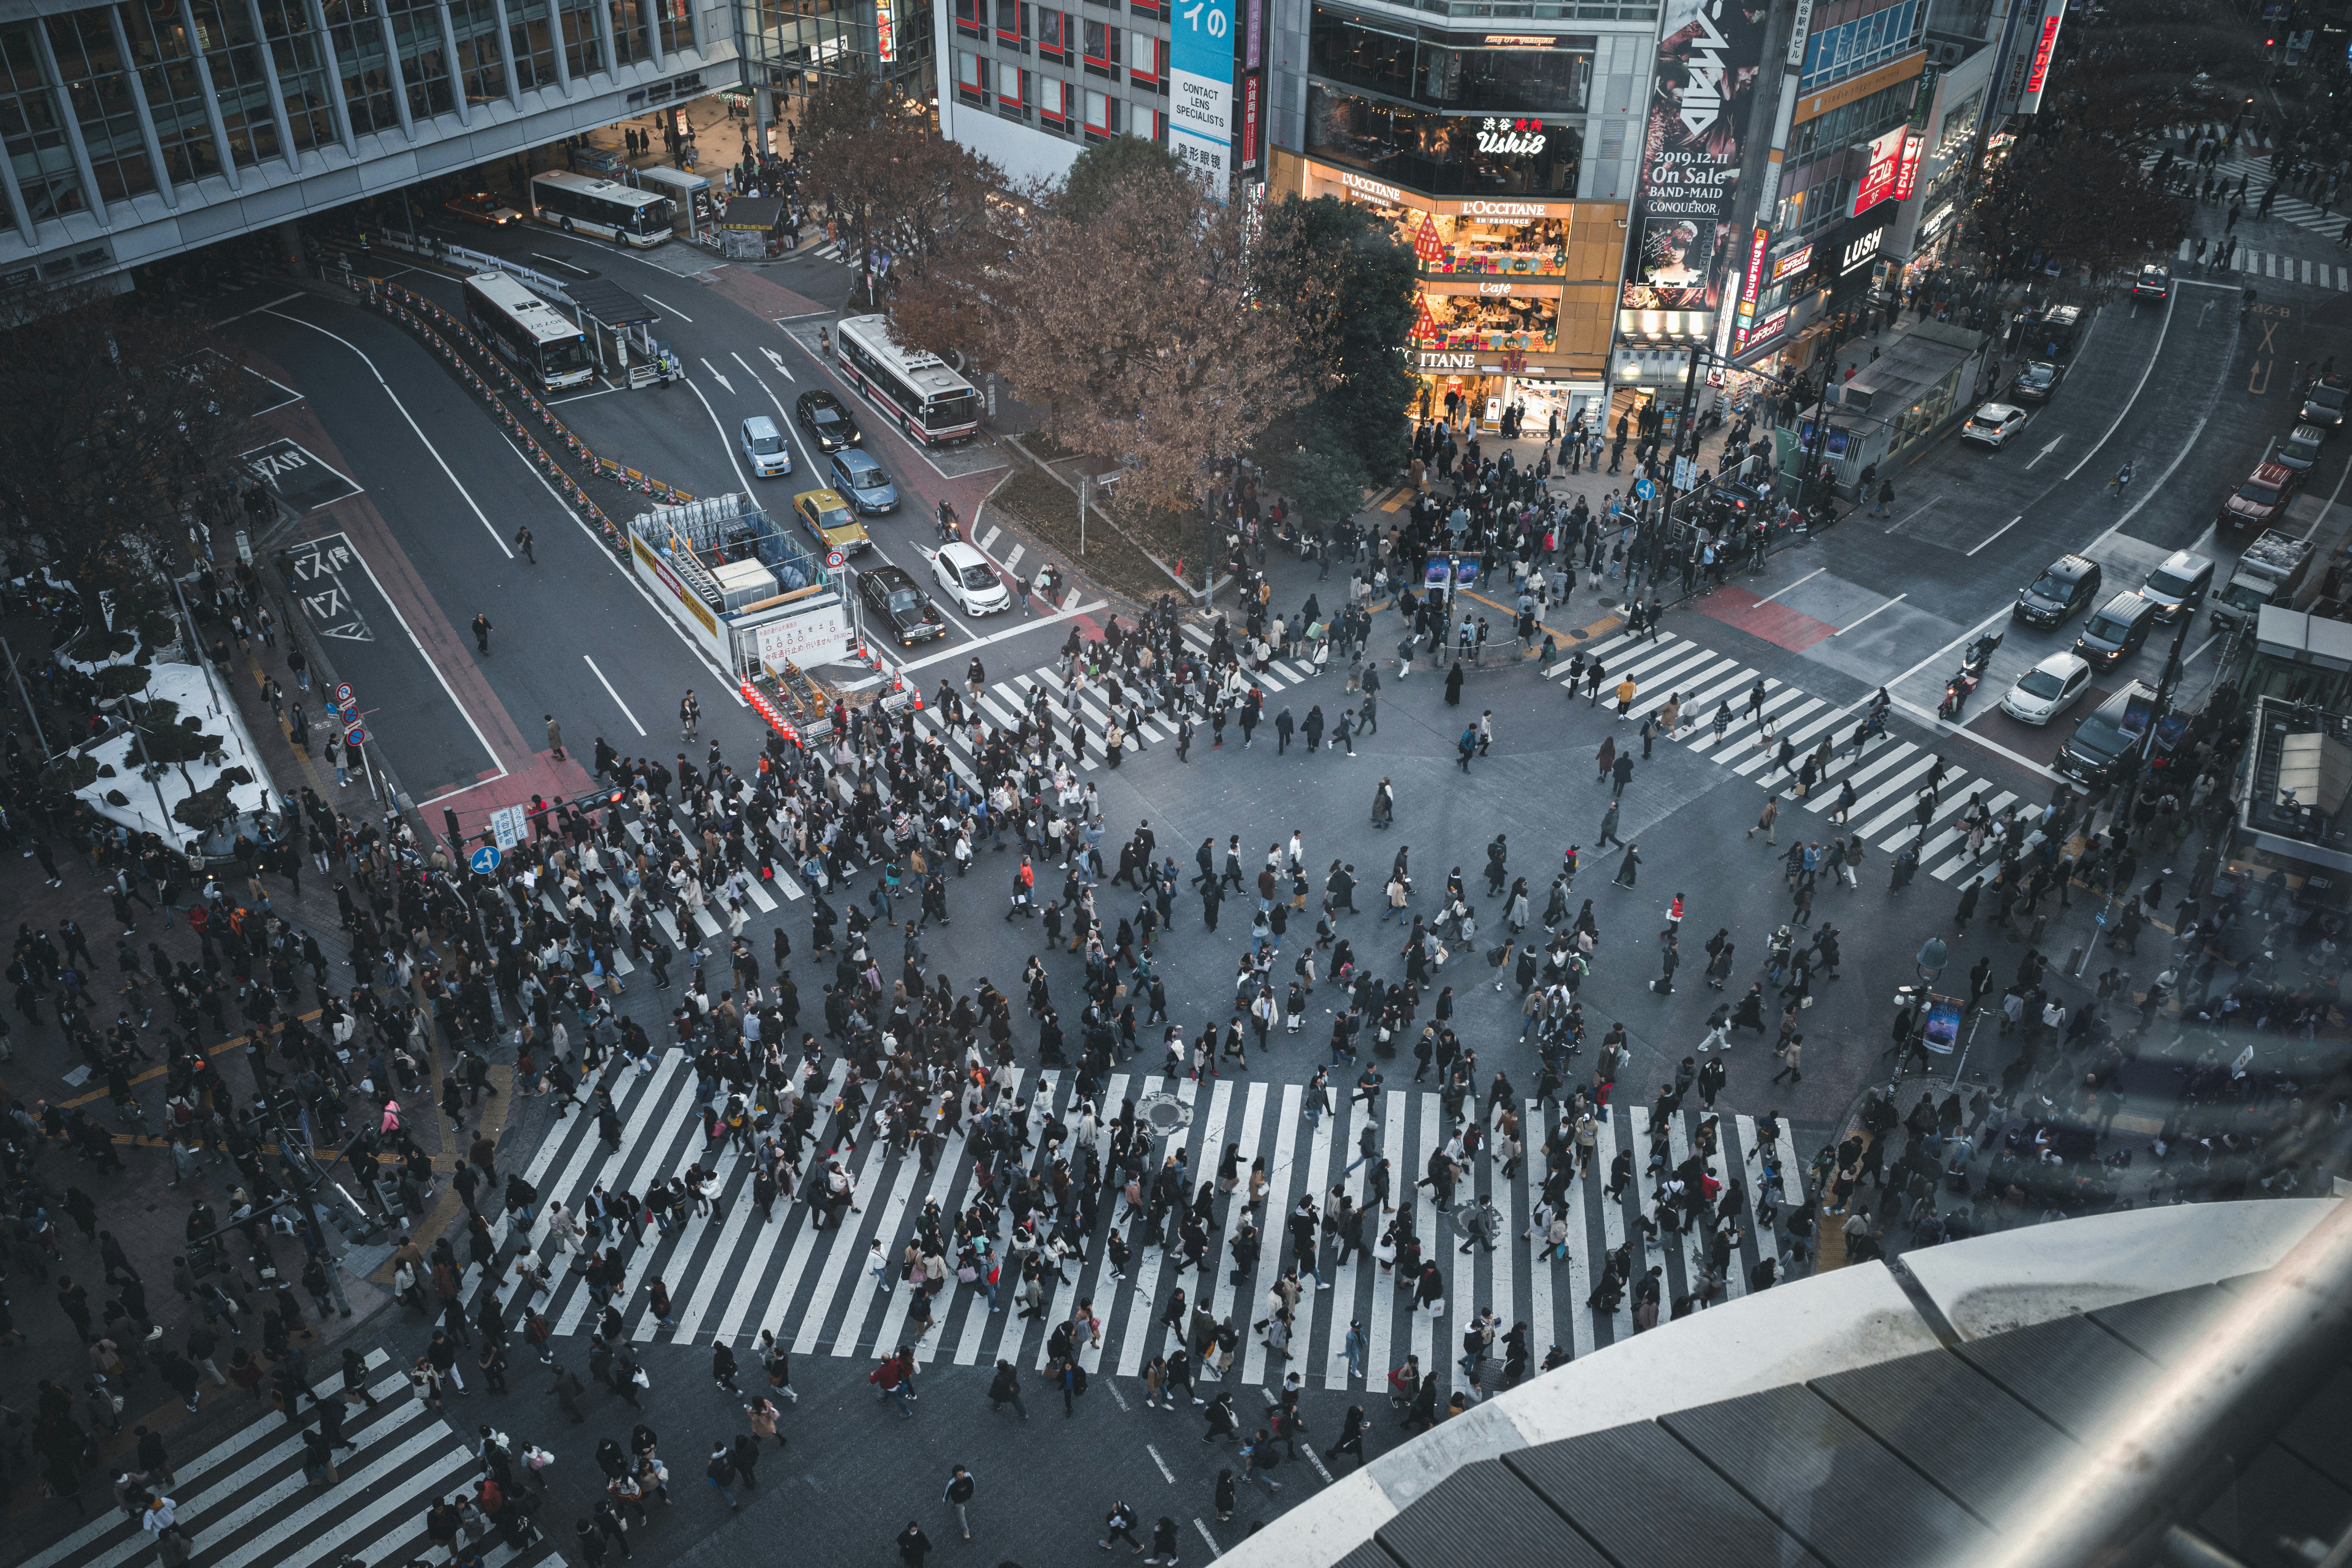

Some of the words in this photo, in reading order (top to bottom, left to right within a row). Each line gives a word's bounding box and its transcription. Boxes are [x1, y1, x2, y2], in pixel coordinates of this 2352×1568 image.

[1248, 57, 1258, 66] 4F
[2027, 16, 2060, 93] ビックカメラ
[1920, 67, 1932, 91] レイク
[1183, 82, 1218, 101] CONTACT
[1247, 78, 1257, 124] 外貨両替
[1191, 96, 1210, 110] LENS
[1176, 104, 1224, 127] SPECIALISTS
[1476, 131, 1546, 154] Ushi8
[1245, 160, 1254, 169] 7F
[1654, 151, 1729, 166] 2019.12.11
[1652, 166, 1679, 183] On
[1684, 167, 1726, 185] Sale
[1866, 160, 1892, 189] アコム
[1898, 163, 1911, 188] アコム
[1342, 172, 1401, 201] L'OCCITANE
[1649, 186, 1723, 198] BAND-MAID
[1870, 189, 1880, 204] 3F
[1462, 200, 1546, 216] L'OCCITANE
[1758, 230, 1765, 238] 薬
[1842, 227, 1883, 268] LUSH
[1746, 249, 1762, 298] サンドラッグ
[1781, 255, 1805, 273] サンドラッグ
[530, 319, 565, 330] 30727
[1678, 459, 1687, 487] 渋谷駅前
[307, 588, 350, 619] バス
[759, 621, 797, 637] 今週の通行止め実施日
[764, 644, 804, 662] 今夜通行止め
[806, 636, 831, 650] 行いません
[499, 812, 514, 846] 渋谷駅前
[1933, 1002, 1958, 1013] SHIBUYA
[1933, 1009, 1957, 1019] WINTER
